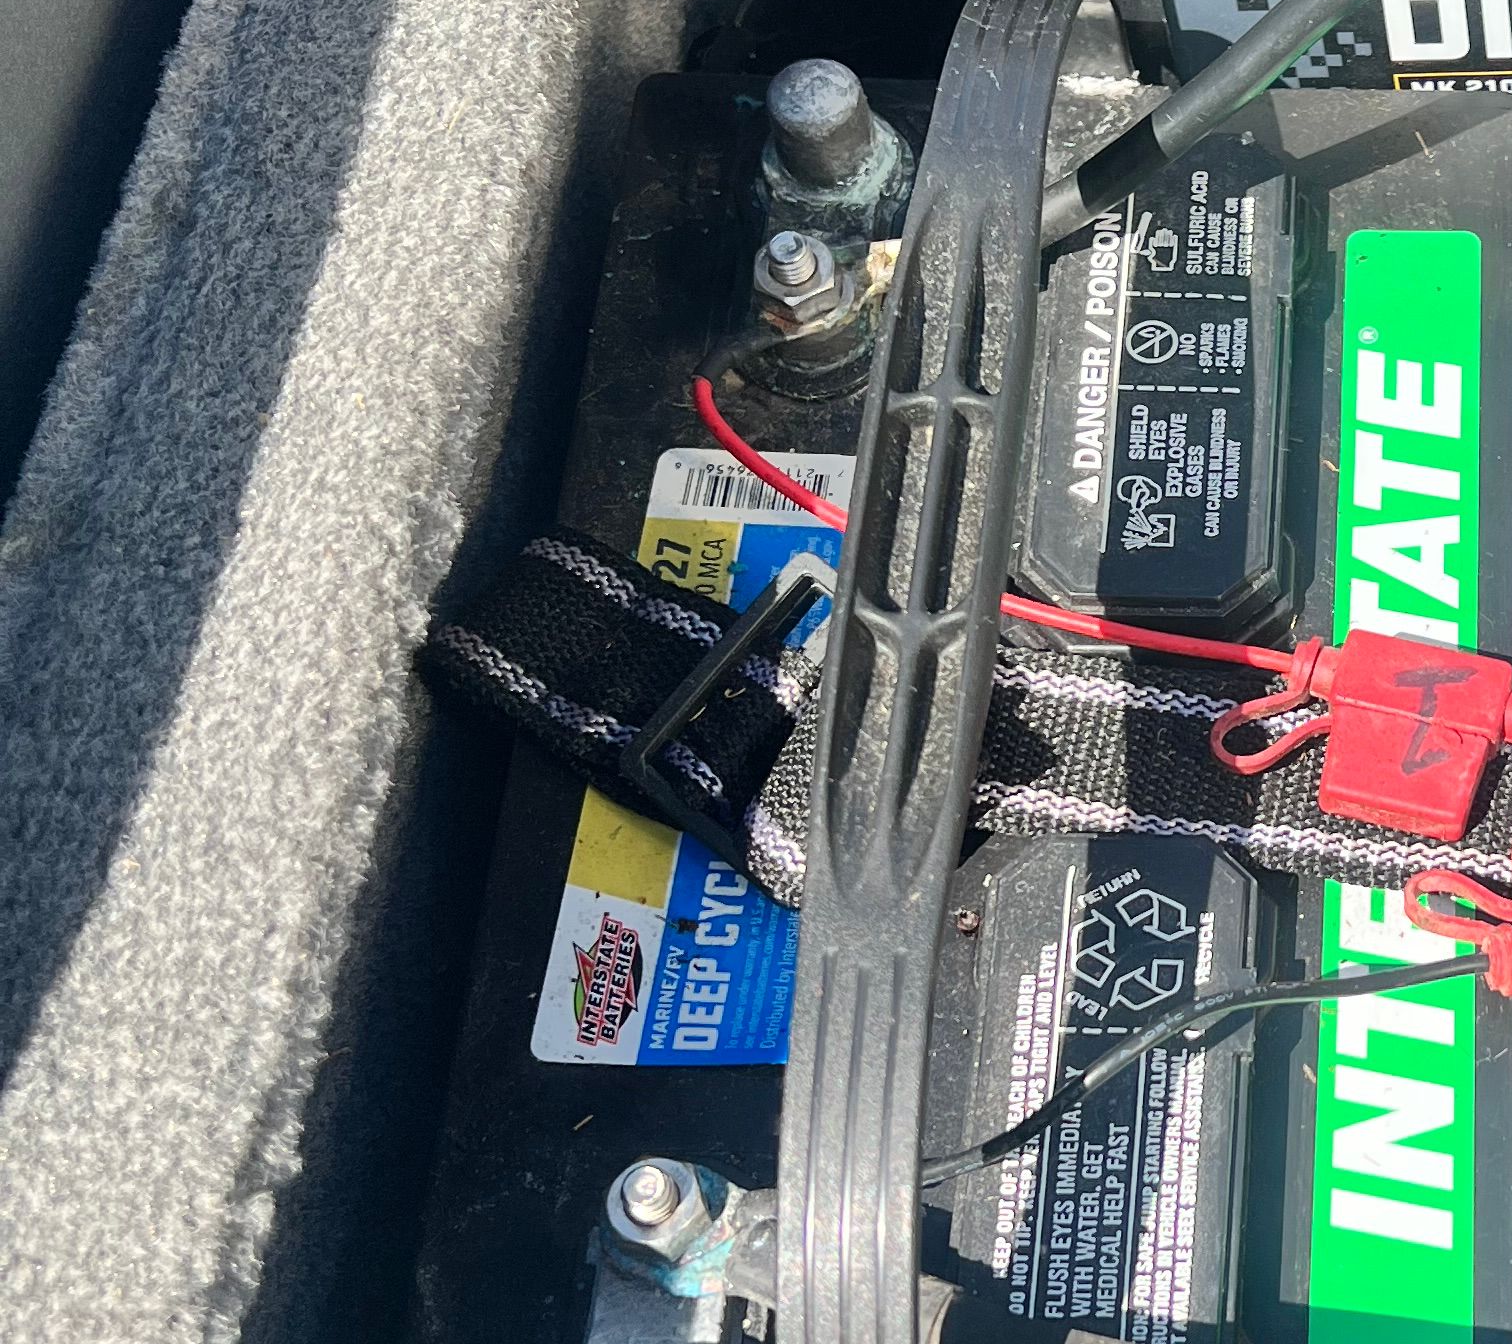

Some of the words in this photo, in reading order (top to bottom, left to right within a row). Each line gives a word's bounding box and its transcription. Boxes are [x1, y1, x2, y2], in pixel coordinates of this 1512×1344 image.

[1190, 170, 1209, 205] ACID
[1186, 205, 1207, 275] SULFURIC
[1207, 212, 1223, 248] CAUSE
[1086, 212, 1122, 316] POISON
[1204, 252, 1219, 275] CAN
[1179, 333, 1196, 355] NO
[1072, 346, 1112, 470] DANGER
[1128, 404, 1149, 460] SHIELD
[1148, 419, 1167, 461] EYES
[1165, 412, 1188, 497] EXPLOSIVE
[1208, 408, 1227, 471] BLINDNESS
[1186, 444, 1205, 498] GASES
[1206, 472, 1223, 511] CAUSE
[1204, 511, 1220, 537] CAN
[697, 538, 727, 580] MCA
[581, 920, 620, 1043] INTERSTATE
[601, 931, 635, 1040] BATTERIES
[1037, 942, 1058, 990] LEVEL
[672, 956, 731, 1051] DEEP
[761, 985, 788, 1050] Distributed
[775, 968, 794, 984] by
[1013, 974, 1036, 1053] CHILDREN
[1034, 991, 1053, 1024] AND
[1011, 1054, 1028, 1077] OF
[1030, 1026, 1050, 1076] TIGHT
[1149, 1048, 1168, 1106] FOLLOW
[1081, 1141, 1104, 1180] GET
[1106, 1123, 1131, 1171] FAST
[1143, 1110, 1164, 1186] STARTING
[1162, 1116, 1182, 1184] OWNERS
[1000, 1172, 1018, 1197] OF
[1180, 1141, 1200, 1206] SERVICE
[997, 1199, 1015, 1233] OUT
[1050, 1199, 1075, 1250] EYES
[1075, 1184, 1102, 1261] WATER.
[1102, 1175, 1126, 1226] HELP
[1158, 1183, 1178, 1249] VEHICLE
[1177, 1207, 1196, 1249] SEEK
[992, 1236, 1012, 1279] KEEP
[1012, 1253, 1029, 1291] NOT
[1095, 1229, 1122, 1318] MEDICAL
[1136, 1232, 1155, 1278] SAFE
[1044, 1253, 1070, 1319] FLUSH
[1069, 1266, 1095, 1318] WITH
[1134, 1281, 1152, 1309] FOR
[1172, 1248, 1193, 1331] AVAILABLE
